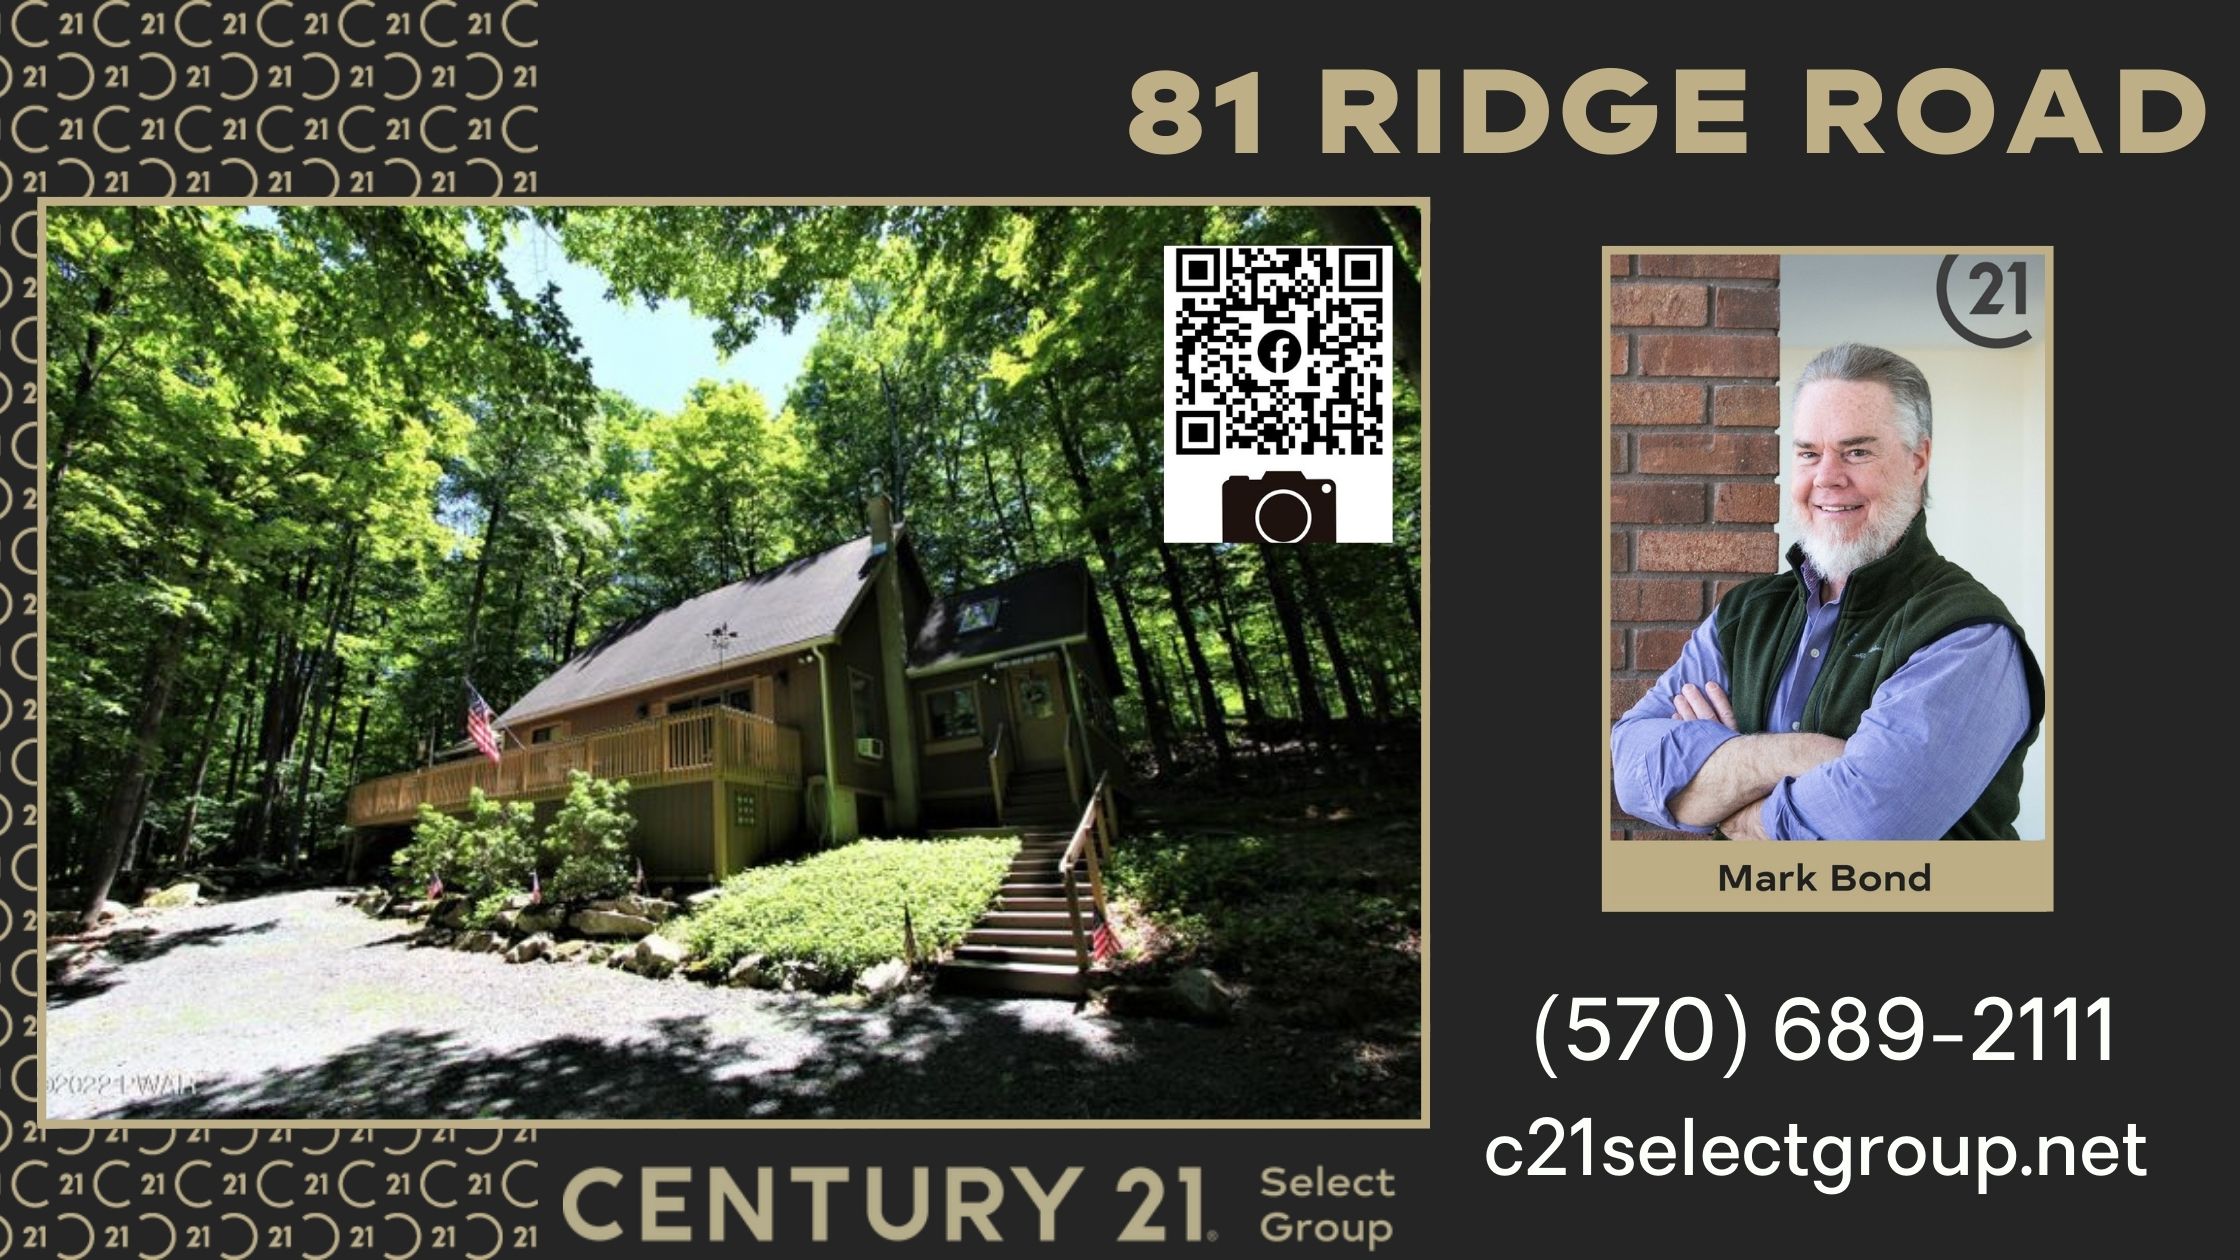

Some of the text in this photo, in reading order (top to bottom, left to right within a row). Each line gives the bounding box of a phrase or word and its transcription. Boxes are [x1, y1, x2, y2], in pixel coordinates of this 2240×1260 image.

[1129, 68, 2207, 156] 81 RIDGE ROAD
[1719, 863, 1931, 892] Mark Bond
[1535, 993, 2111, 1079] (570) 689-2111
[1260, 1165, 1396, 1197] Select
[1485, 1116, 2148, 1192] c21selectgroup.net
[563, 1166, 1084, 1242] CENTURY
[1260, 1211, 1393, 1252] Group
